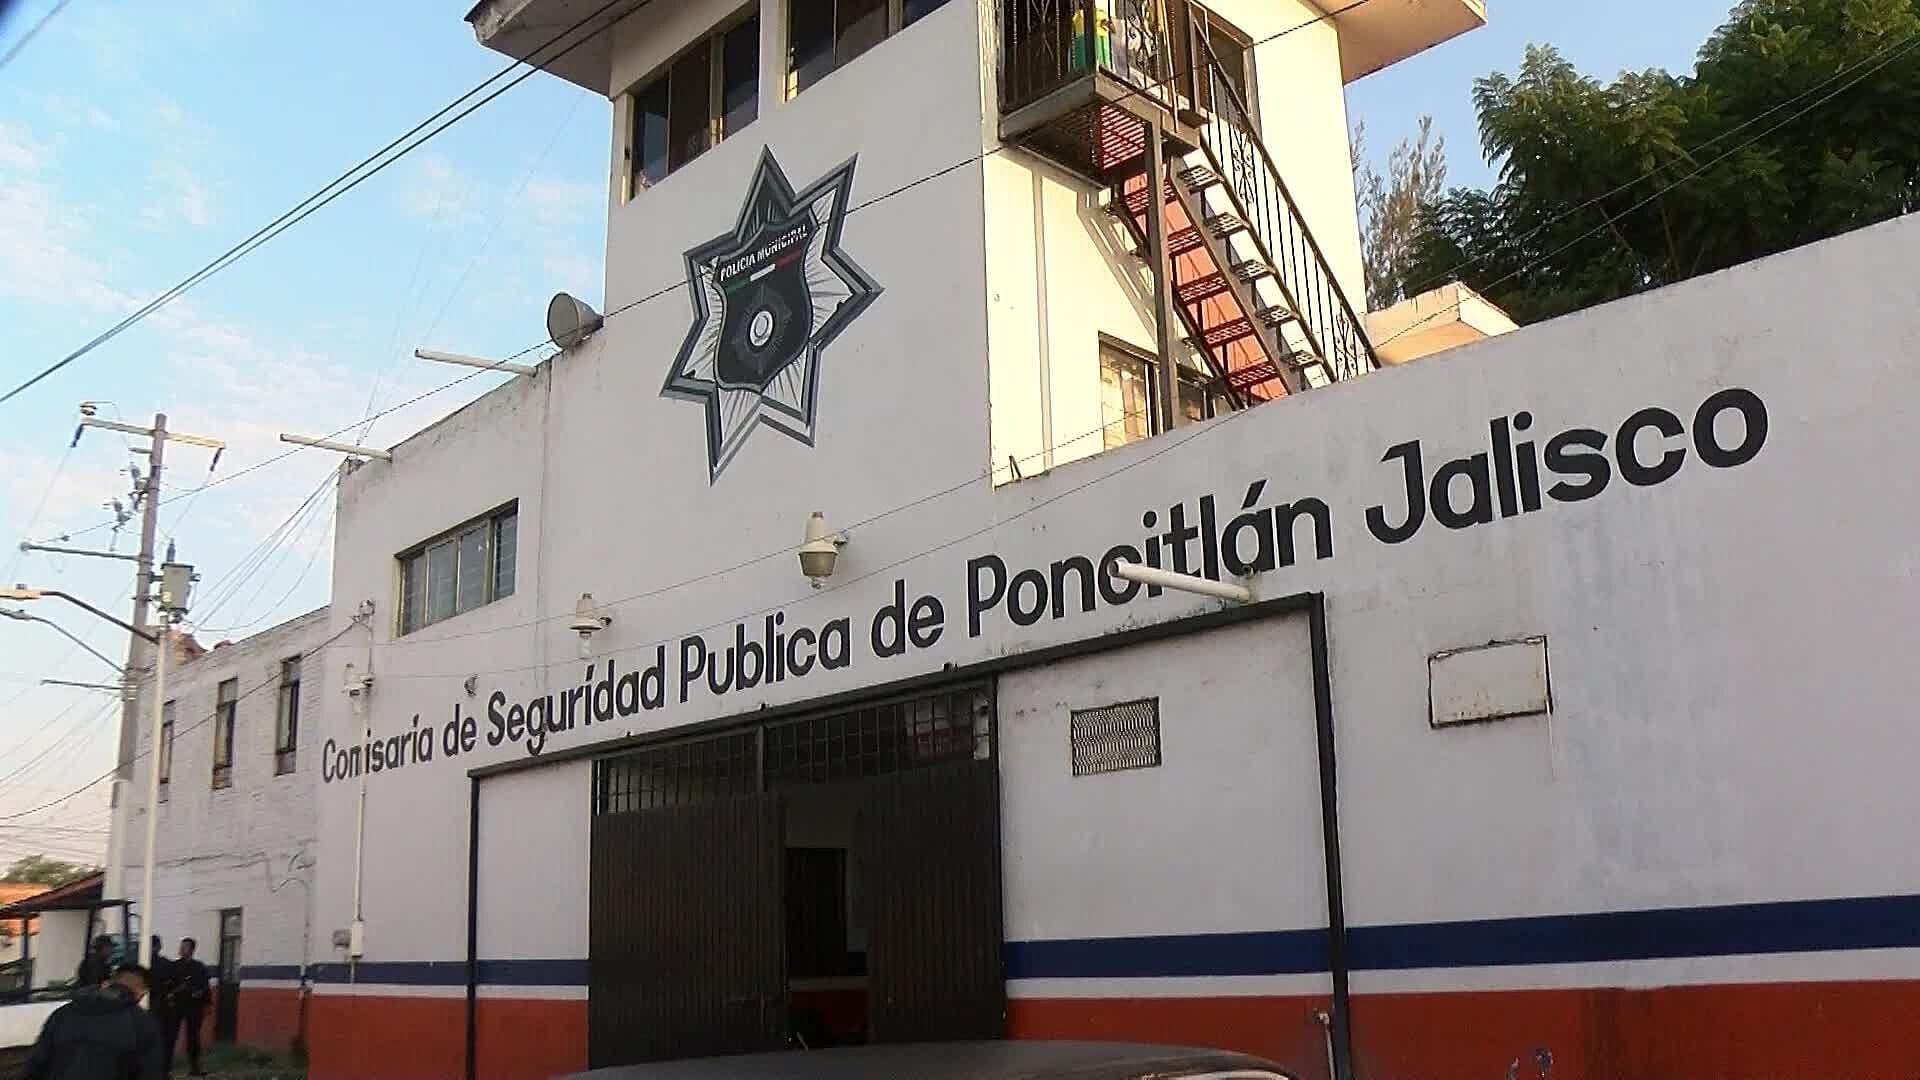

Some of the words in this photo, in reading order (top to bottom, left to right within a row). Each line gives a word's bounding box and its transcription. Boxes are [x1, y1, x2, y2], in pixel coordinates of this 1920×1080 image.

[720, 253, 756, 281] POLICIA
[757, 224, 808, 262] MUNICIPAL
[443, 703, 477, 757] de
[680, 611, 852, 703] Publica
[871, 579, 945, 658] de
[967, 479, 1333, 638] Poncitlán
[1365, 388, 1769, 545] Jalisco
